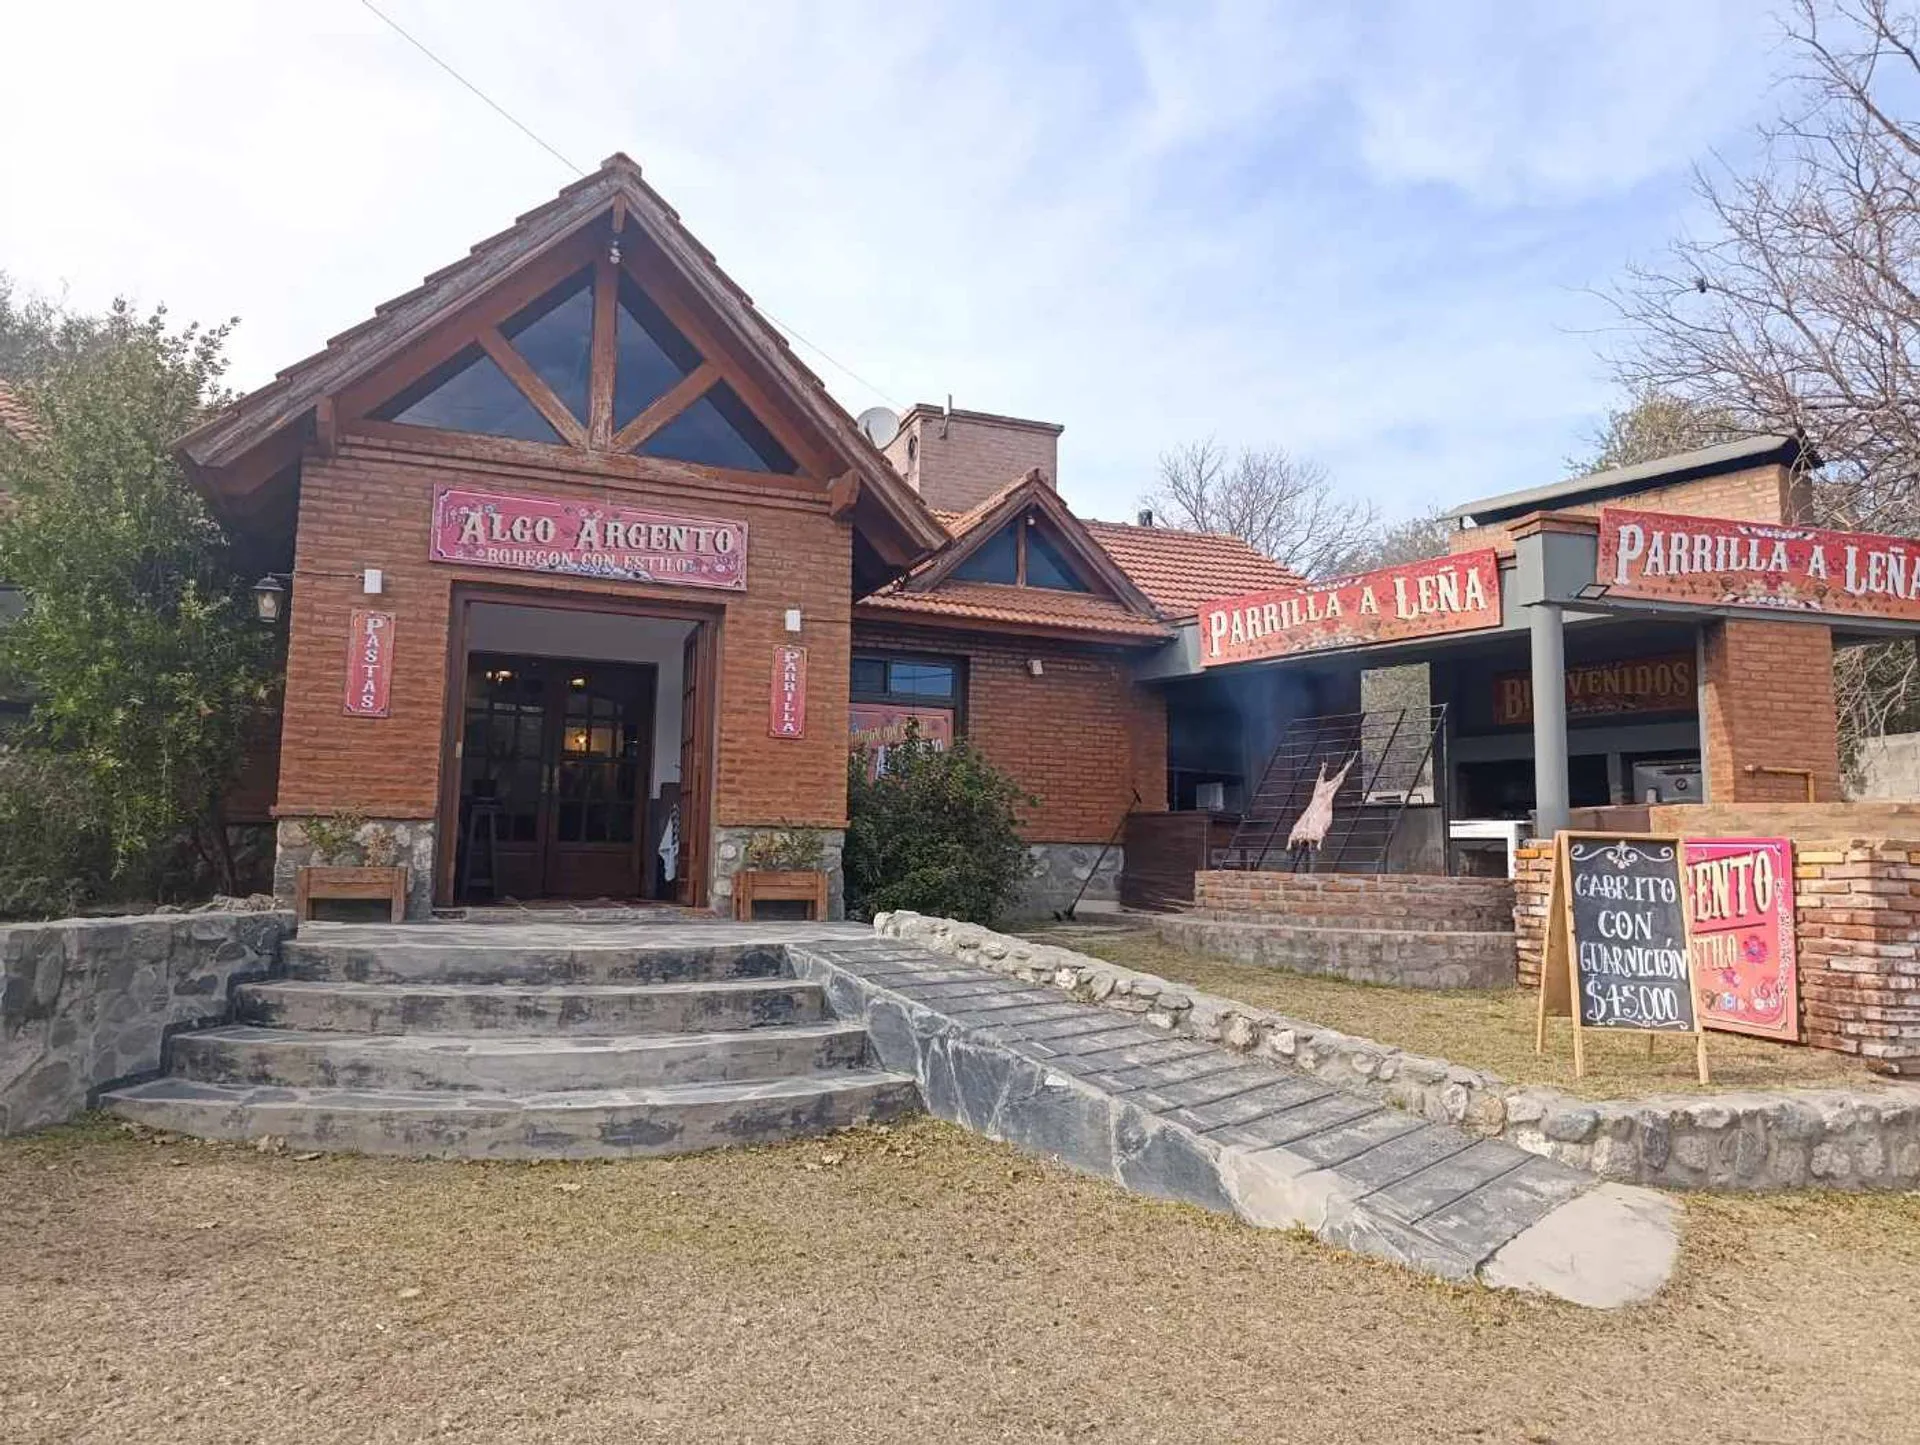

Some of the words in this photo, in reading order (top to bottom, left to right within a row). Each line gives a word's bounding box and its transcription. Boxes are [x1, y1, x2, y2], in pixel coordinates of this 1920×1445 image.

[458, 511, 556, 545] ALGO
[574, 516, 734, 553] ARGENTO
[1614, 523, 1789, 585] PARRILLA
[1807, 544, 1828, 580] A
[488, 546, 573, 567] BODEGON
[581, 552, 616, 569] CON
[624, 555, 687, 573] ESTILO
[1208, 591, 1342, 657] PARRILLA
[1359, 585, 1380, 615] A
[1392, 566, 1488, 620] LEÑA
[361, 618, 384, 708] PASTAS
[783, 652, 799, 732] PARRILLA
[1502, 662, 1690, 719] BIVENIDOS
[1575, 873, 1676, 904] CABRITO
[1598, 910, 1653, 941] CON
[1579, 938, 1687, 980] GUARNICIÓN
[1692, 934, 1737, 970] STILO
[1586, 974, 1679, 1024] $45.000
